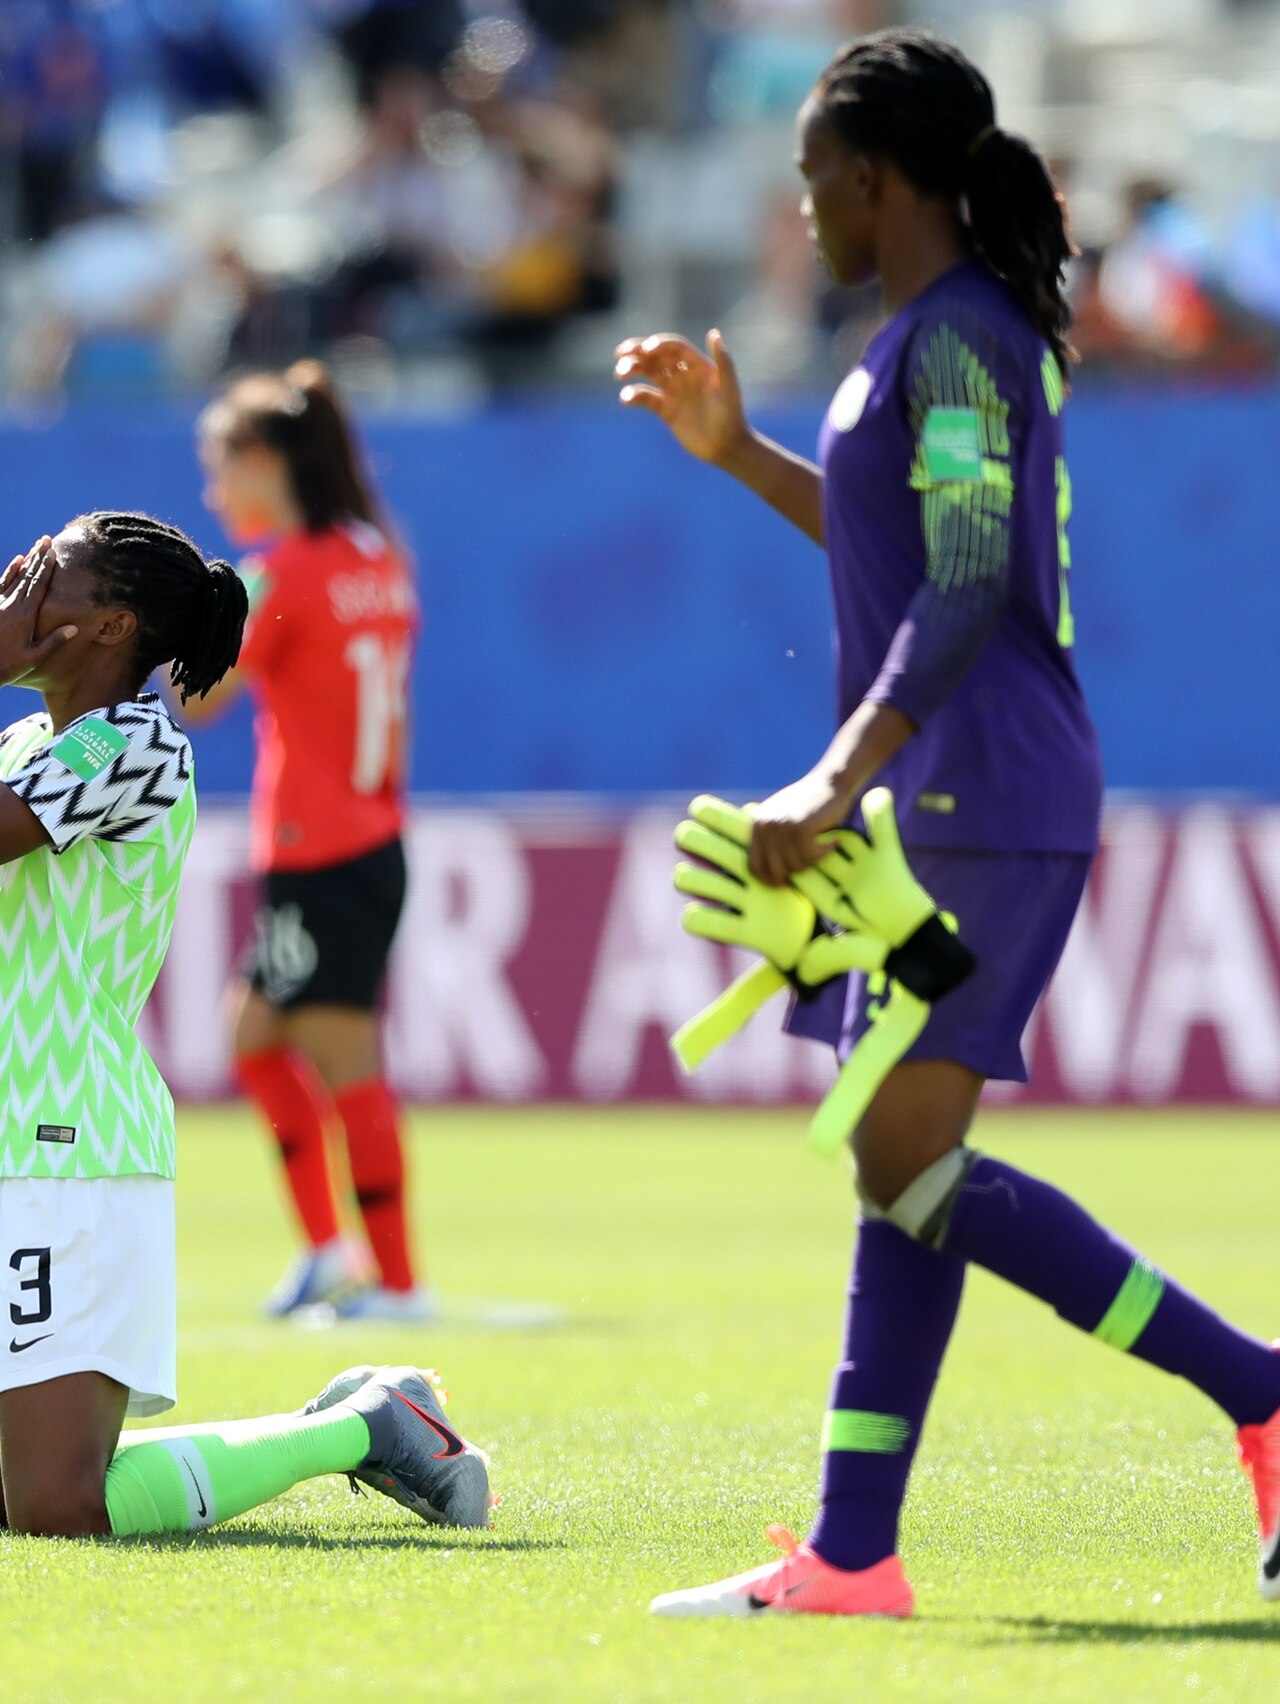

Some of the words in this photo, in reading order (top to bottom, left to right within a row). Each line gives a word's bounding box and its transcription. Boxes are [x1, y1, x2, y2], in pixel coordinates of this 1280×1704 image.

[74, 730, 110, 760] FOOTBALL
[78, 725, 116, 755] LIVING
[82, 751, 101, 771] FIFA
[9, 1245, 51, 1325] 3
